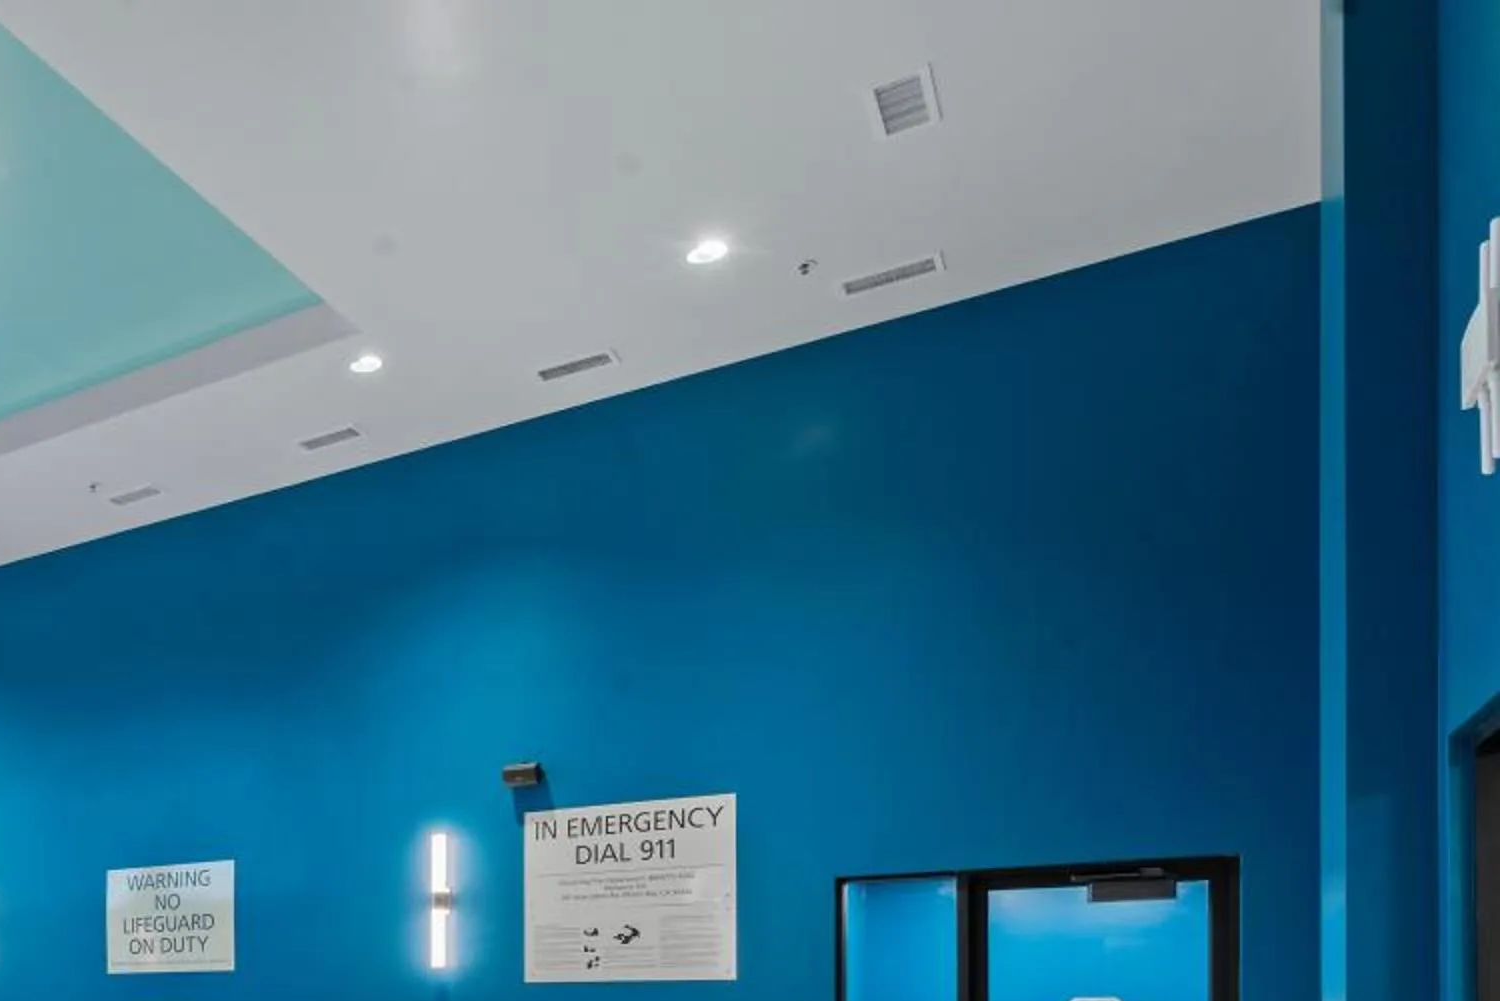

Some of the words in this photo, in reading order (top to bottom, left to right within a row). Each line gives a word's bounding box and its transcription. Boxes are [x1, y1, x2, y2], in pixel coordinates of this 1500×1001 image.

[534, 819, 557, 841] IN
[567, 805, 724, 839] EMERGENCY
[575, 842, 631, 865] DIAL
[640, 838, 676, 861] 911
[126, 869, 212, 892] WARNING
[155, 893, 181, 911] NO
[122, 913, 215, 935] LIFEGUARD
[129, 938, 155, 955] ON
[160, 935, 209, 954] DUTY
